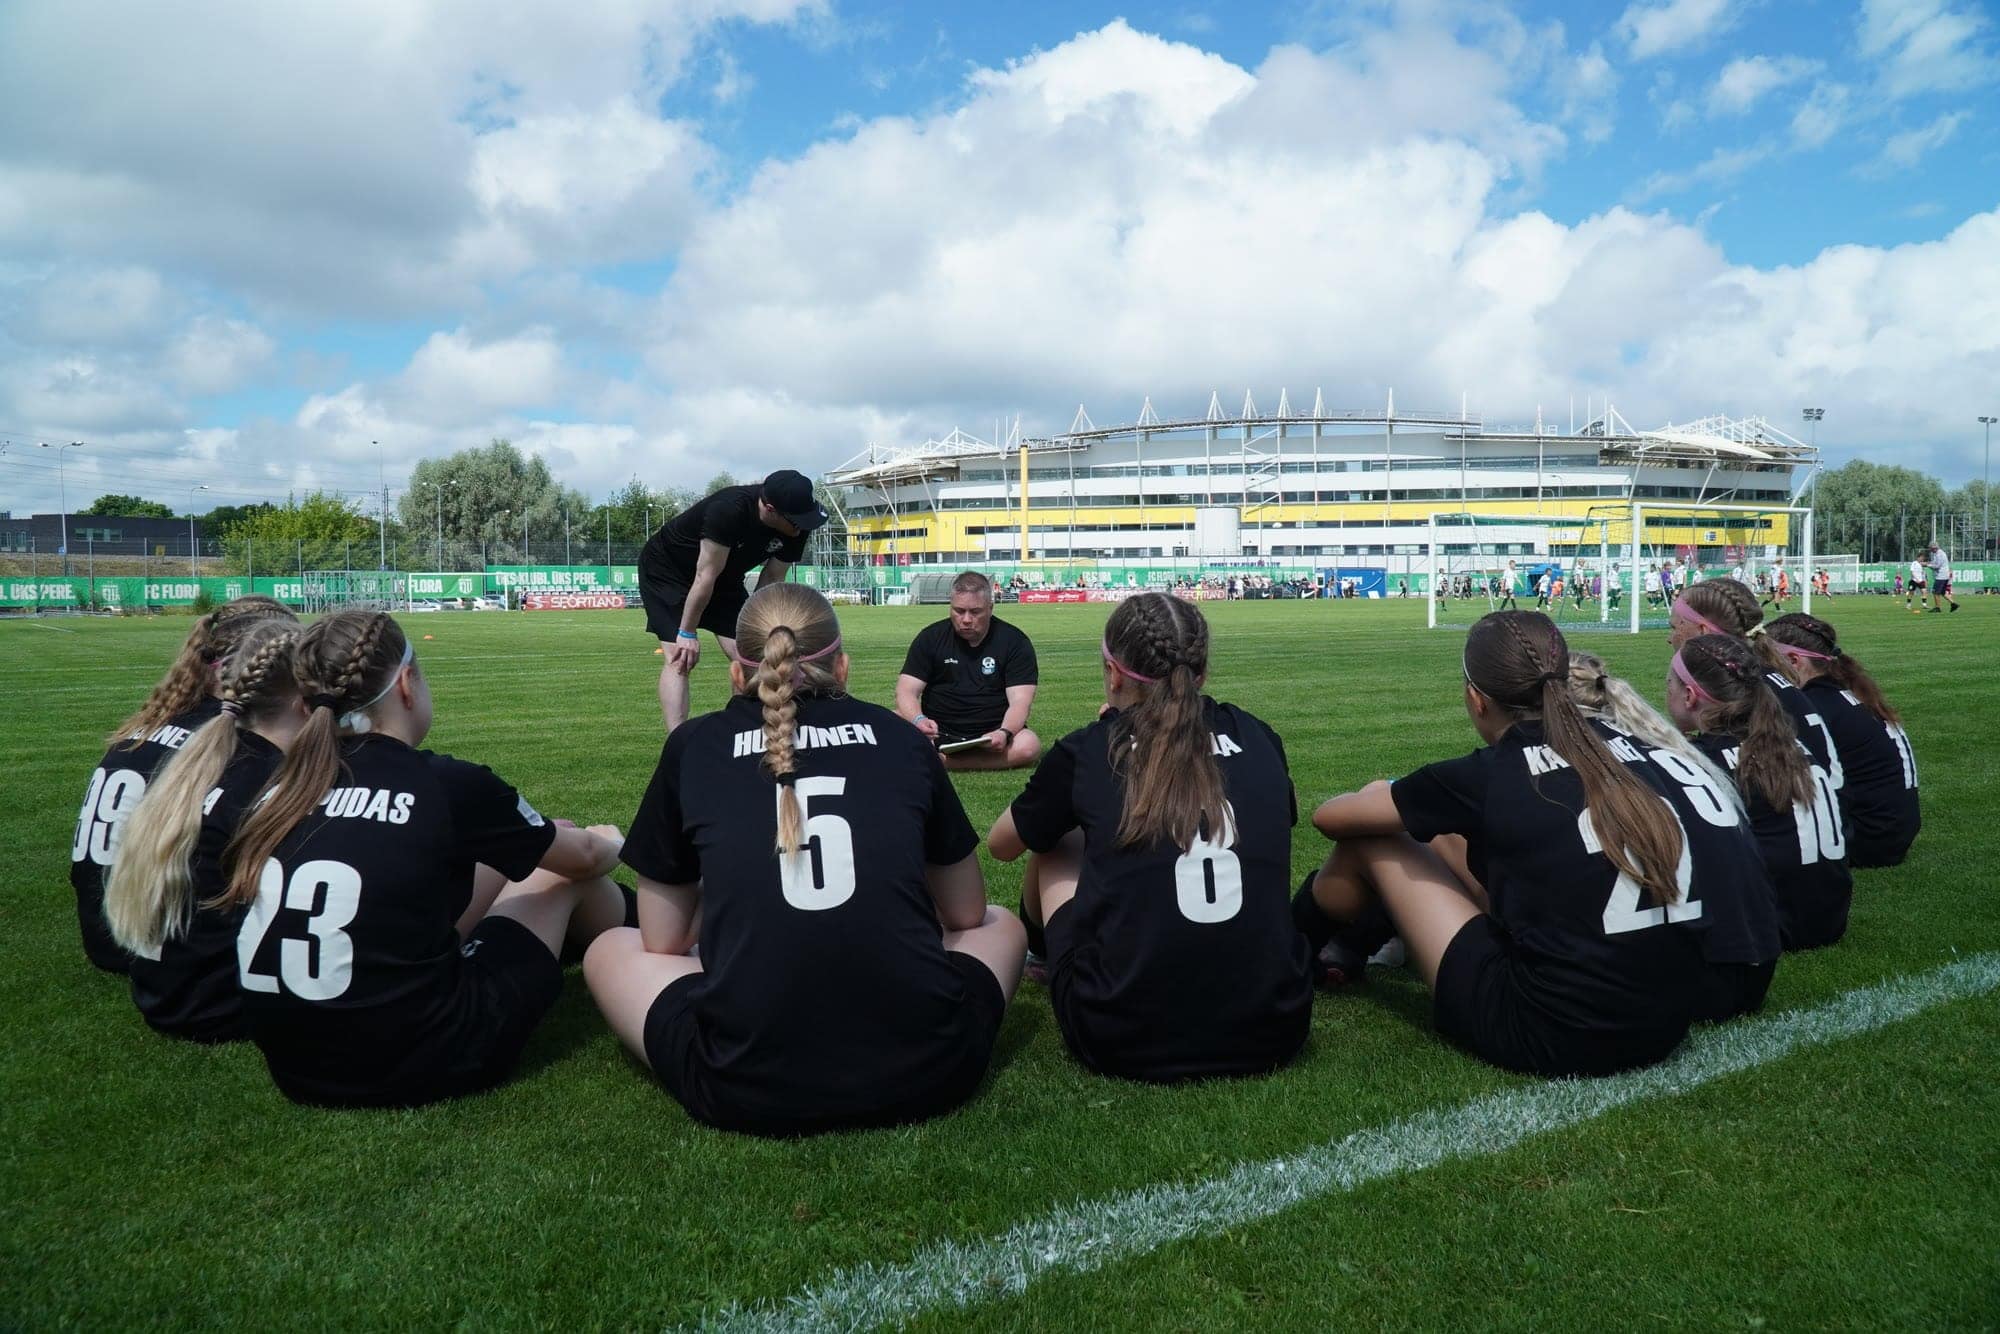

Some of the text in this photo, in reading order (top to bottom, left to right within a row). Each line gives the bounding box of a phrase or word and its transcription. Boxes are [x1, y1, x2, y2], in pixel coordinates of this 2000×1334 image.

[573, 572, 599, 585] PERE.
[144, 584, 200, 599] FC FLORA
[273, 584, 289, 599] FC
[551, 595, 623, 608] SPORTLAND
[733, 723, 878, 759] HUVINEN
[775, 775, 856, 911] 5
[236, 855, 362, 1001] 23
